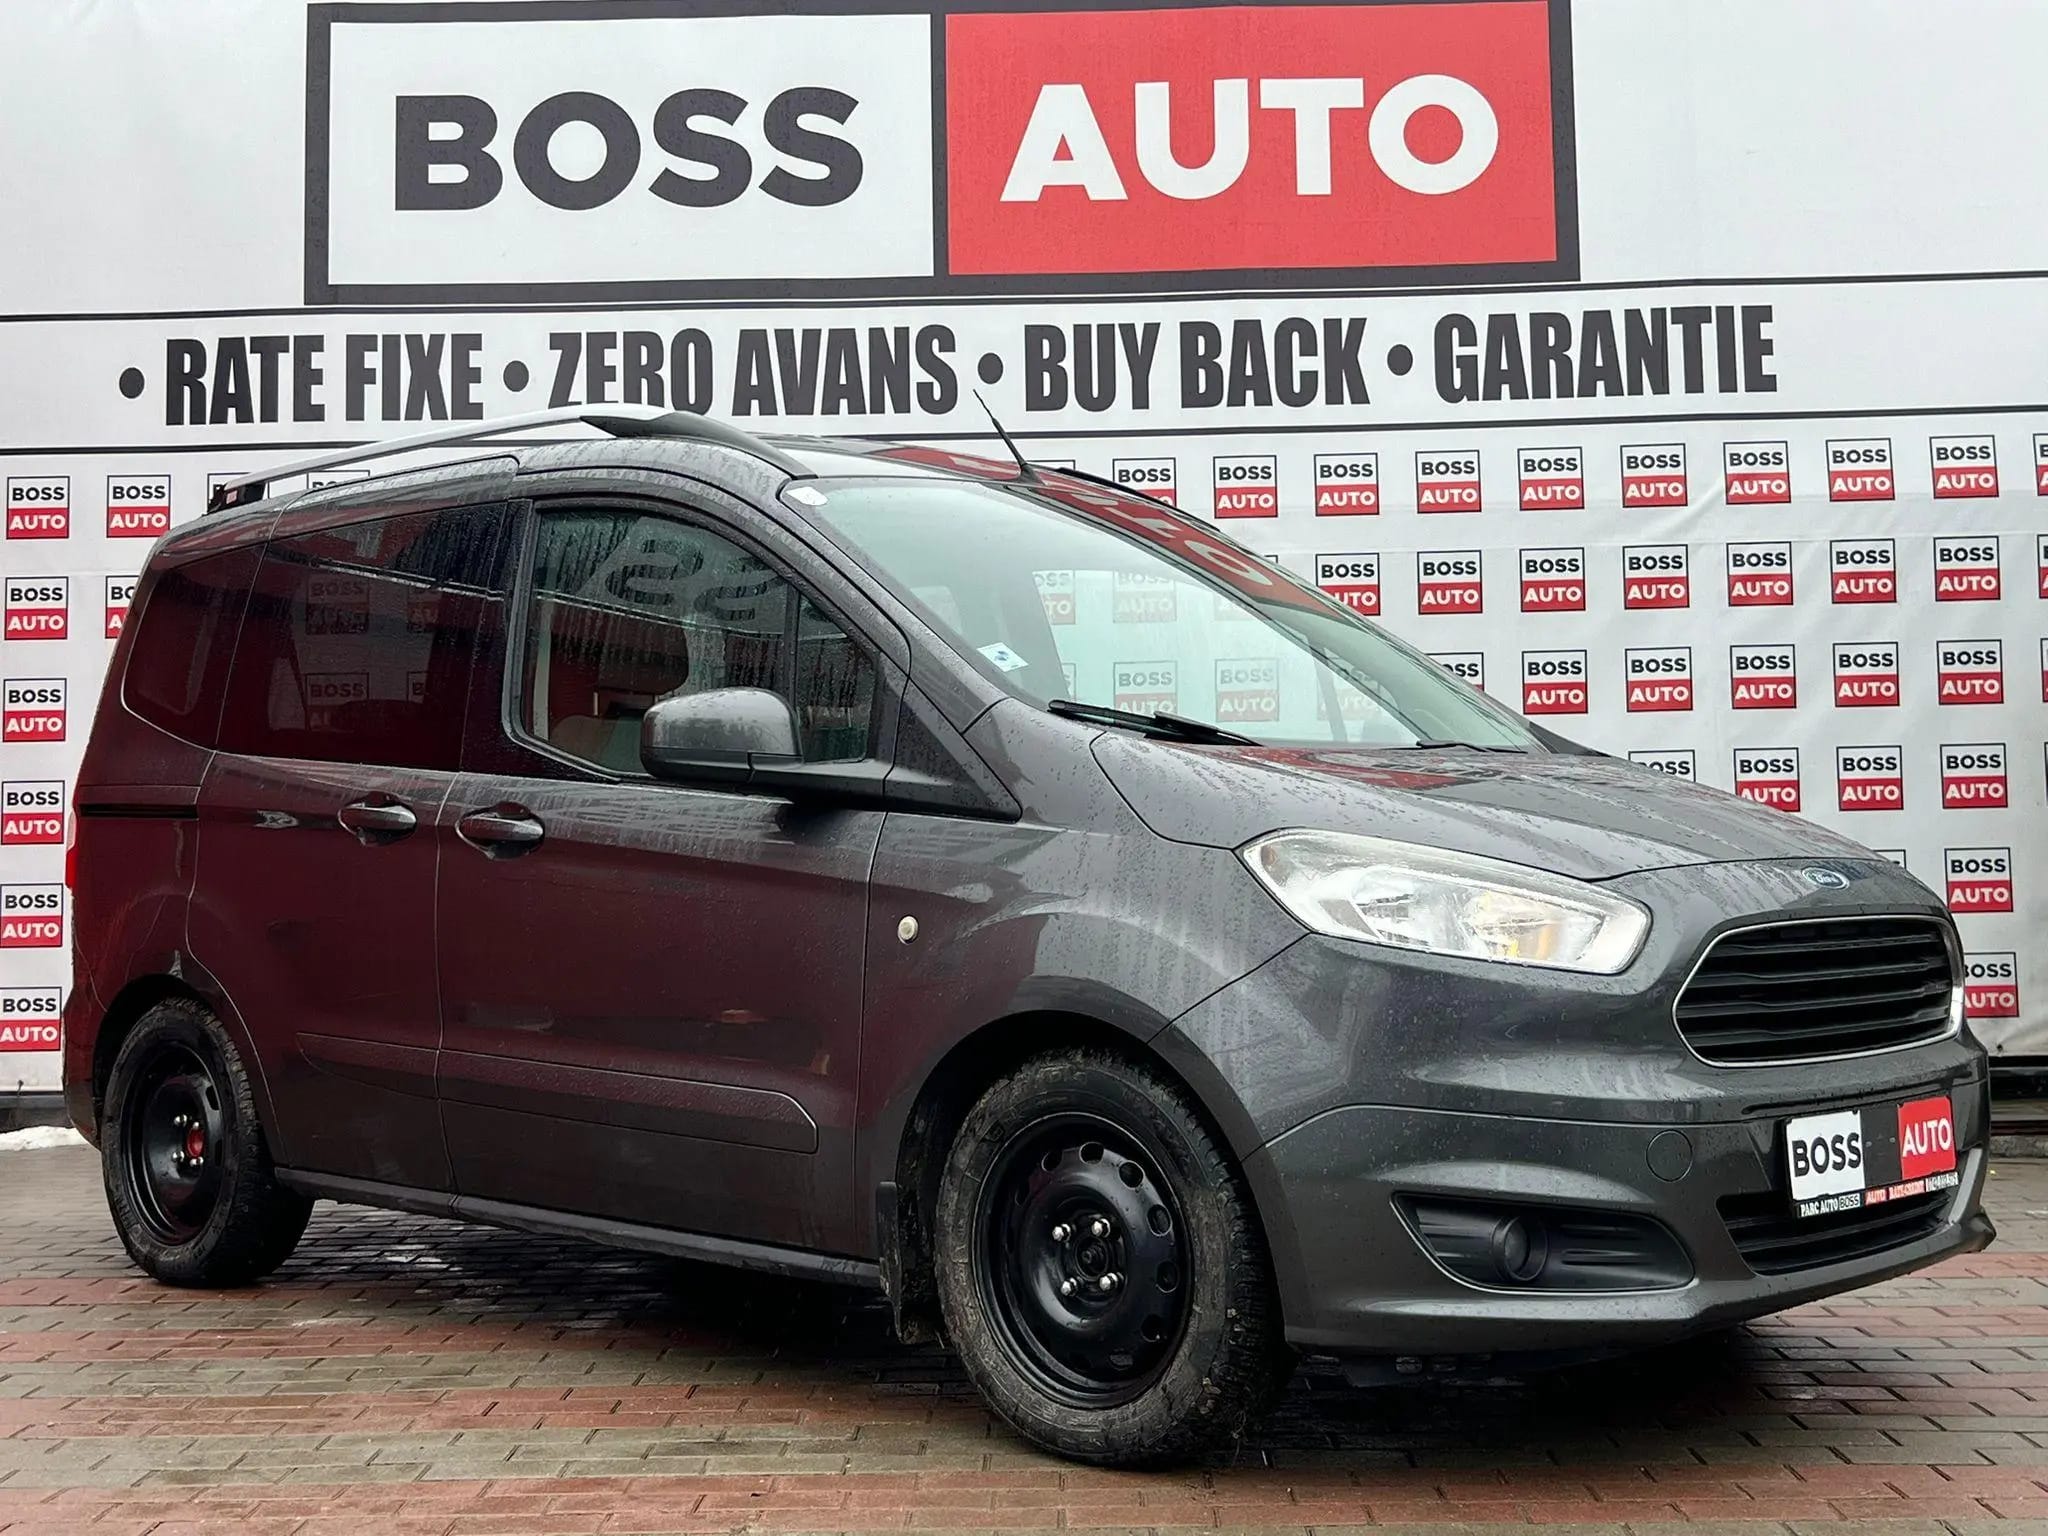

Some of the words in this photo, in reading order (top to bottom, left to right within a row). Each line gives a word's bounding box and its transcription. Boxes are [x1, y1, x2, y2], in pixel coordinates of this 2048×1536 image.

[395, 87, 863, 210] BOSS
[1000, 74, 1498, 201] AUTO
[166, 334, 325, 425] RATE
[345, 333, 483, 421] FIXE
[548, 328, 713, 415] ZERO
[732, 325, 958, 416] AVANS
[1024, 322, 1161, 412] BUY
[1179, 318, 1371, 408] BACK
[1434, 305, 1777, 403] GARANTIE
[1730, 452, 1783, 466] BOSS
[1833, 449, 1886, 463] BOSS
[1936, 446, 1990, 460] BOSS
[1422, 461, 1475, 475] BOSS
[1524, 458, 1577, 472] BOSS
[1627, 454, 1680, 469] BOSS
[1119, 469, 1171, 482] BOSS
[1219, 466, 1271, 480] BOSS
[1320, 464, 1373, 478] BOSS
[1729, 479, 1786, 495] AUTO
[1832, 476, 1889, 492] AUTO
[1936, 473, 1993, 489] AUTO
[13, 487, 64, 501] BOSS
[113, 486, 165, 499] BOSS
[1420, 488, 1478, 504] AUTO
[1523, 485, 1580, 501] AUTO
[1626, 482, 1683, 498] AUTO
[1217, 494, 1274, 509] AUTO
[1318, 491, 1376, 506] AUTO
[11, 515, 65, 529] AUTO
[111, 513, 166, 528] AUTO
[1733, 553, 1786, 567] BOSS
[1836, 550, 1890, 564] BOSS
[1940, 547, 1994, 562] BOSS
[1423, 561, 1477, 576] BOSS
[1526, 558, 1579, 573] BOSS
[1629, 555, 1683, 570] BOSS
[1322, 564, 1374, 578] BOSS
[1732, 581, 1789, 596] AUTO
[1835, 579, 1892, 594] AUTO
[1939, 576, 1997, 591] AUTO
[11, 587, 63, 601] BOSS
[1334, 592, 1377, 606] UTO
[1422, 589, 1479, 605] AUTO
[1524, 587, 1582, 602] AUTO
[1628, 584, 1686, 599] AUTO
[9, 615, 64, 630] AUTO
[1631, 658, 1686, 673] BOSS
[1736, 655, 1790, 670] BOSS
[1839, 653, 1893, 668] BOSS
[1943, 651, 1997, 665] BOSS
[1220, 666, 1274, 683] BOSS
[1528, 661, 1582, 675] BOSS
[1118, 672, 1173, 687] BOSS
[1943, 679, 1999, 694] AUTO
[9, 689, 61, 703] BOSS
[310, 682, 364, 698] BOSS
[1527, 689, 1584, 704] AUTO
[1630, 686, 1689, 702] AUTO
[1735, 684, 1792, 700] AUTO
[1839, 682, 1895, 697] AUTO
[1218, 698, 1276, 714] AUTO
[7, 718, 62, 732] AUTO
[1740, 759, 1794, 773] BOSS
[1843, 757, 1897, 771] BOSS
[1946, 754, 2001, 769] BOSS
[1842, 786, 1899, 801] AUTO
[1946, 783, 2003, 798] AUTO
[7, 791, 59, 806] BOSS
[5, 820, 60, 834] AUTO
[1951, 858, 2006, 873] BOSS
[5, 894, 58, 909] BOSS
[1951, 888, 2008, 903] AUTO
[3, 923, 59, 938] AUTO
[3, 998, 56, 1012] BOSS
[1, 1027, 57, 1042] AUTO
[1792, 1133, 1861, 1177] BOSS
[1903, 1117, 1952, 1158] AUTO
[1820, 1199, 1838, 1214] AUTO
[1840, 1195, 1859, 1209] BOSS
